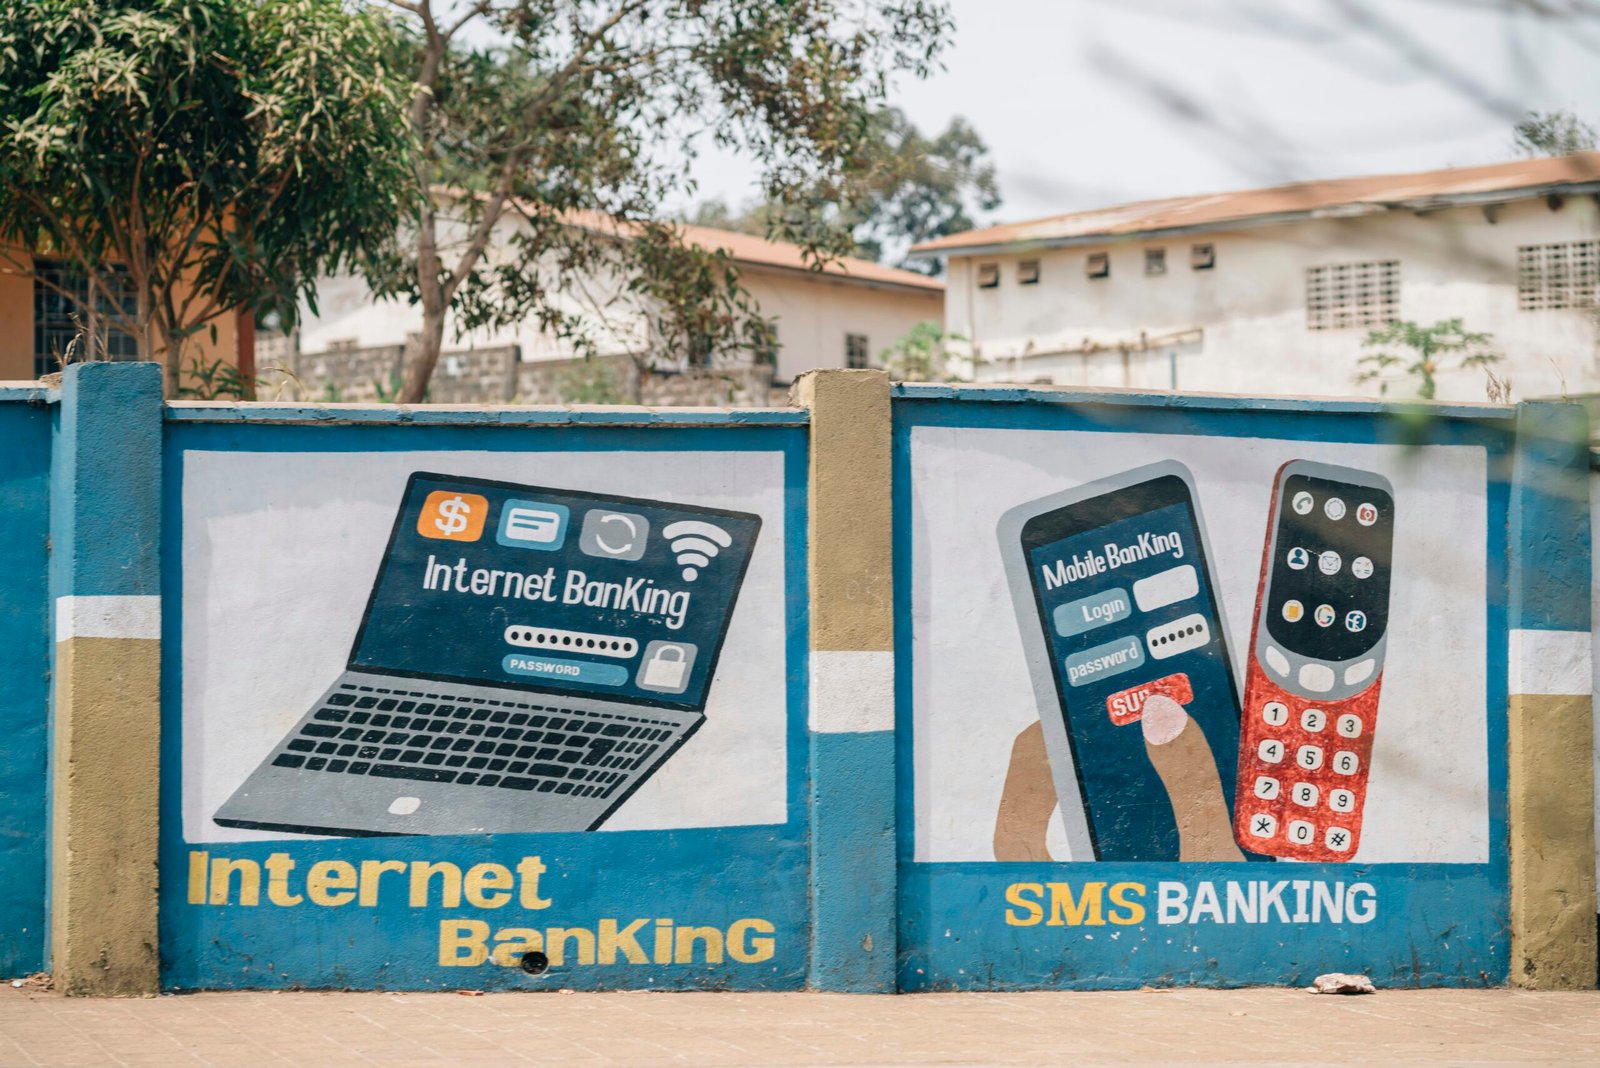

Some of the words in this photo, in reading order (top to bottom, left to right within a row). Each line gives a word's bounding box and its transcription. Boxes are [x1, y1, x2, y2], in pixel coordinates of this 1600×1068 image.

[422, 554, 557, 602] Internet
[1041, 550, 1107, 590] Mobile
[1081, 599, 1125, 622] Login
[510, 659, 580, 676] PASSWORD
[1069, 642, 1139, 682] password
[1271, 707, 1279, 721] 1
[1307, 714, 1317, 728] 2
[1345, 719, 1355, 733] 3
[1266, 744, 1277, 757] 4
[1305, 751, 1316, 765] 5
[1341, 756, 1351, 770] 6
[1261, 781, 1273, 794] 7
[1301, 787, 1311, 801] 8
[1337, 794, 1348, 808] 9
[187, 850, 552, 910] Internet
[1004, 881, 1147, 927] SMS
[1157, 880, 1377, 925] BANKING
